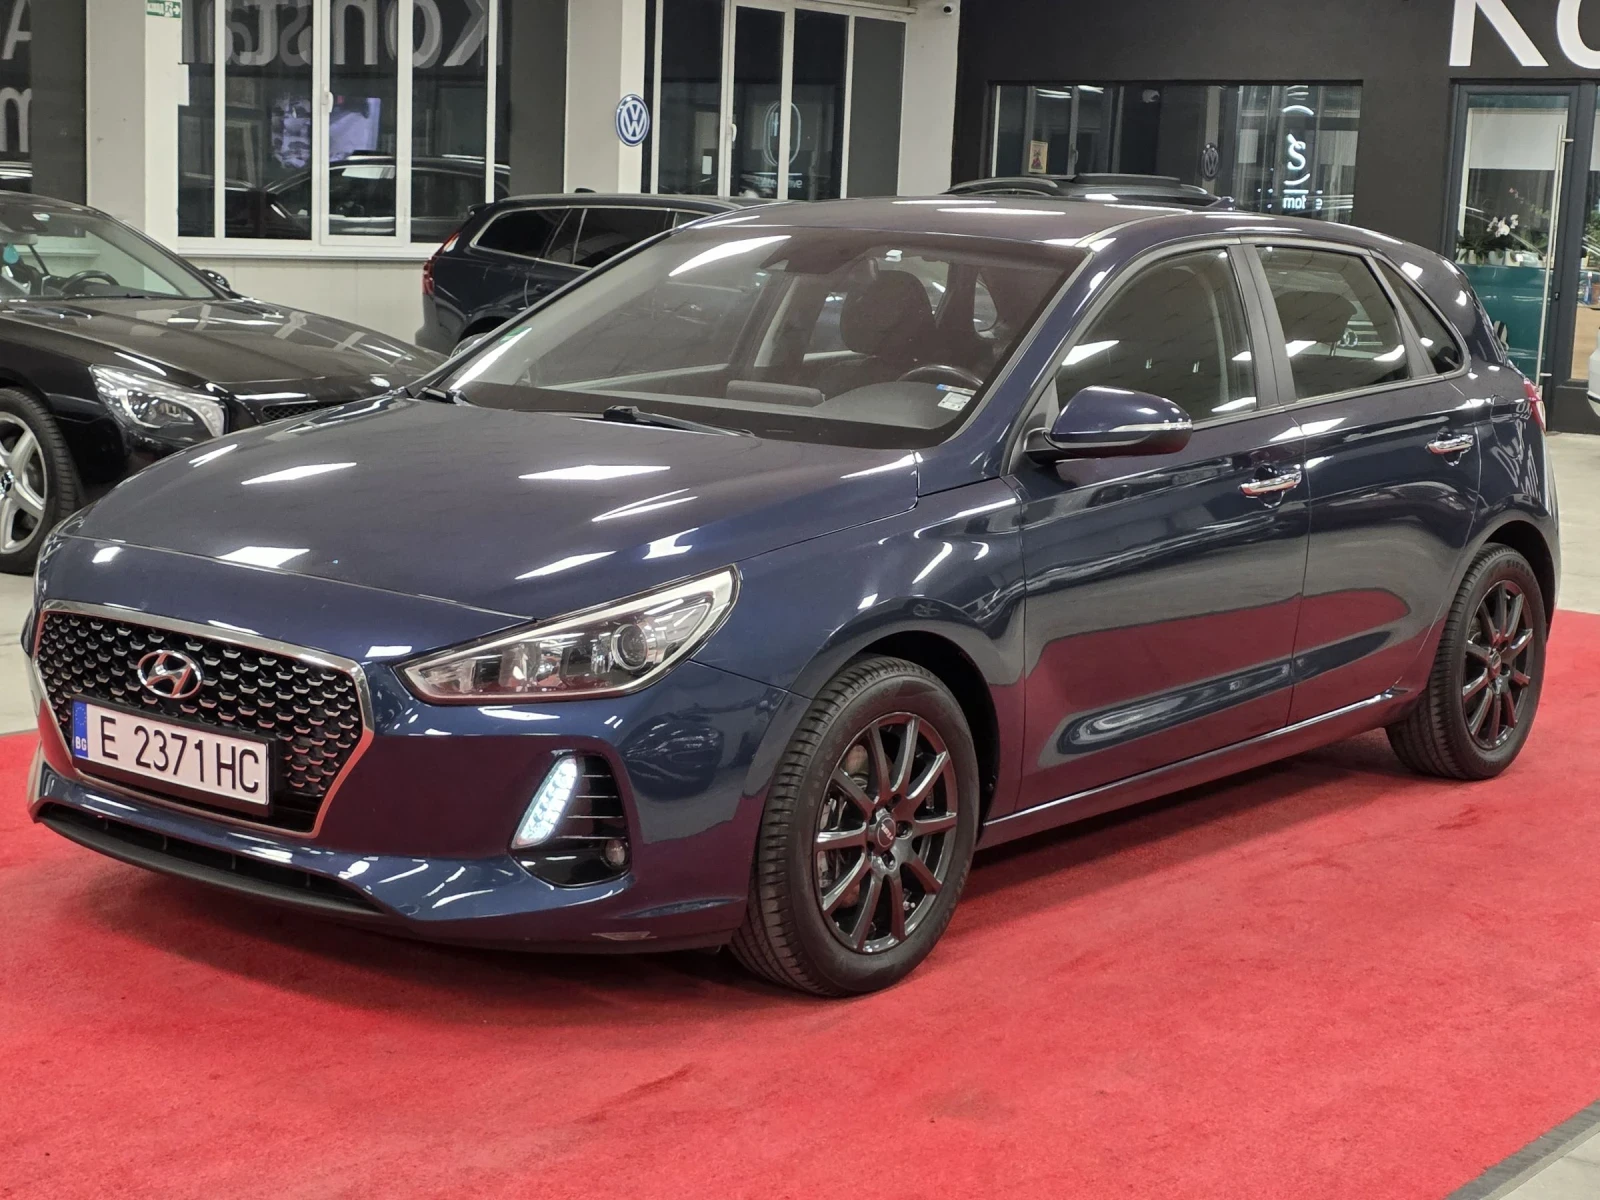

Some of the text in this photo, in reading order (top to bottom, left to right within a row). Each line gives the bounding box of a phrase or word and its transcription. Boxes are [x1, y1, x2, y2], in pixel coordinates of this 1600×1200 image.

[75, 736, 88, 751] BG
[101, 715, 259, 793] E 2371 HC
